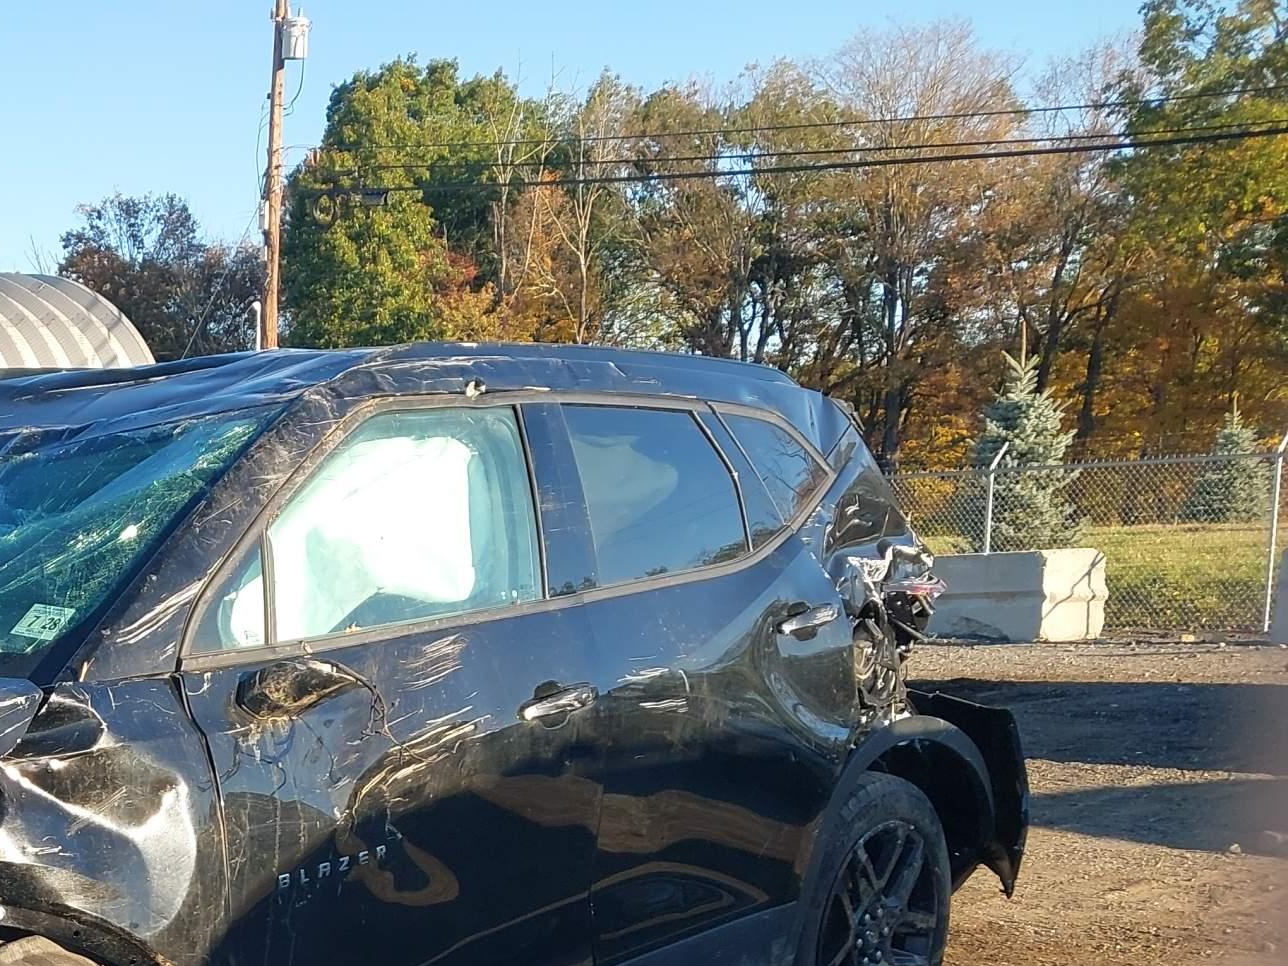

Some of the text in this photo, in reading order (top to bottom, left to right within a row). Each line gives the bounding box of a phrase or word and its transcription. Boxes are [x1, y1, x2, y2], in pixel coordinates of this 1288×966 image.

[27, 615, 42, 628] 7
[40, 616, 61, 631] 28
[277, 844, 387, 888] BLAZER
